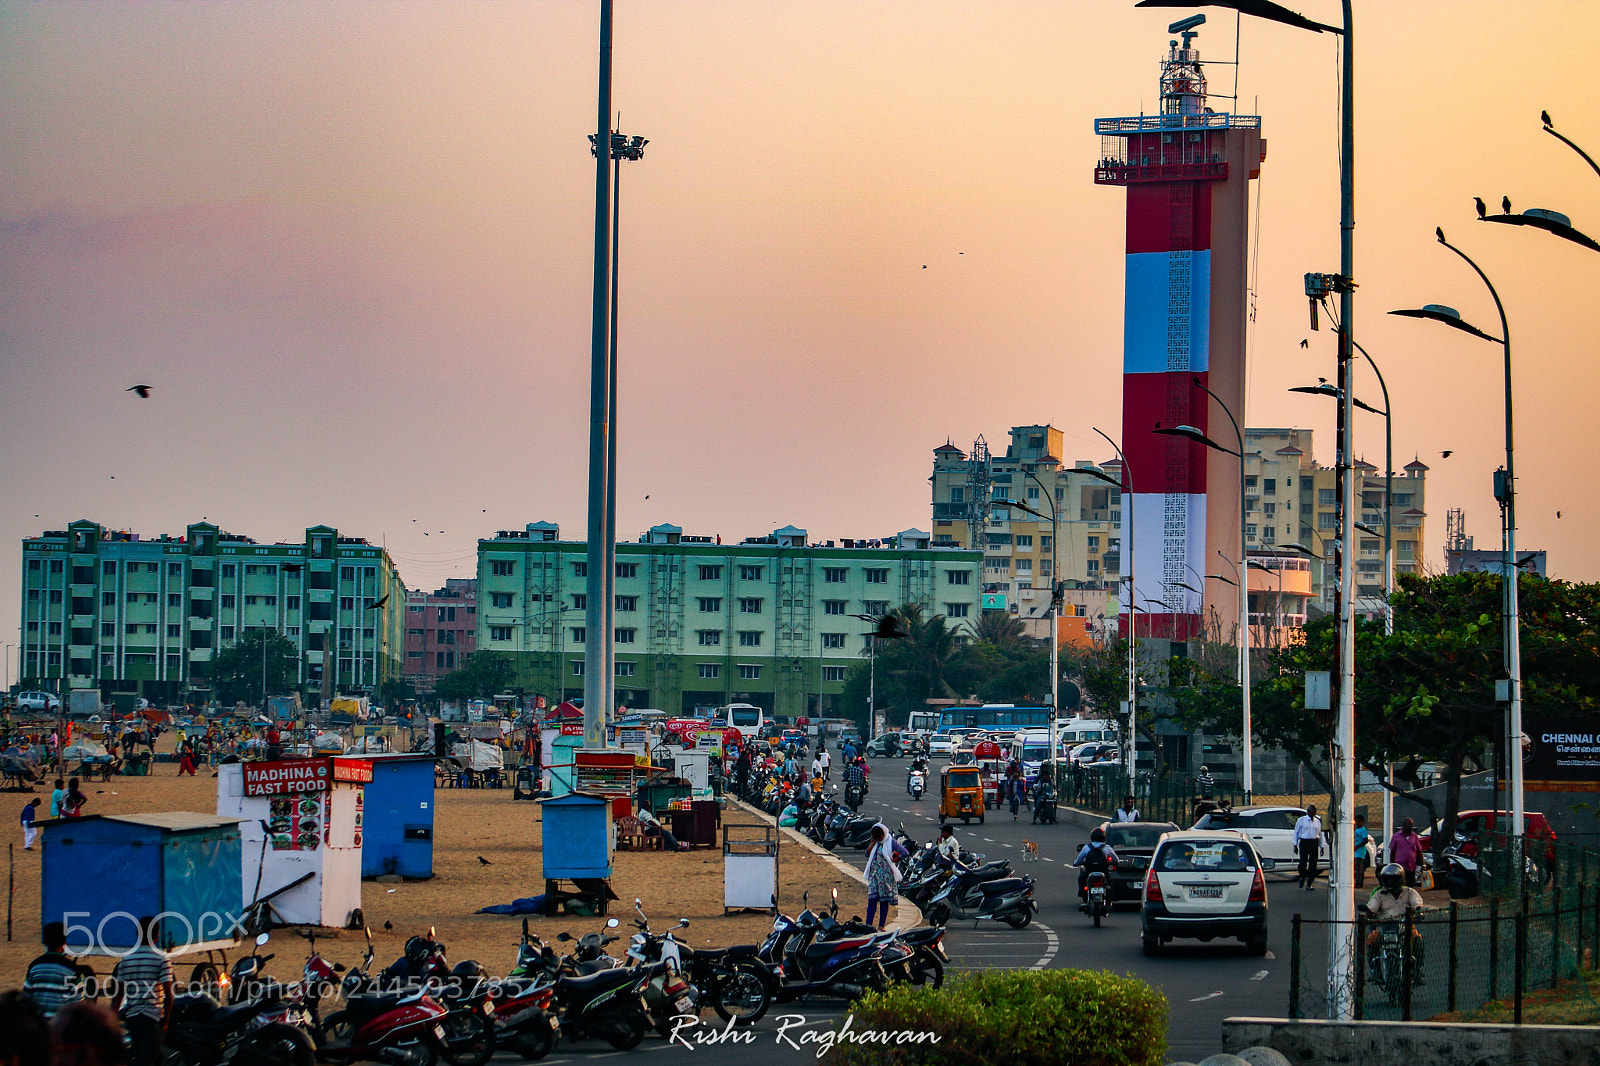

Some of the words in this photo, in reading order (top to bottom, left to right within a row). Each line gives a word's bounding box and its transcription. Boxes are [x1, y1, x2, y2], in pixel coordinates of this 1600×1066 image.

[1541, 733, 1594, 744] CHENNAI
[247, 766, 314, 783] MADHINA
[248, 782, 281, 796] FAST
[287, 780, 327, 793] FOOD
